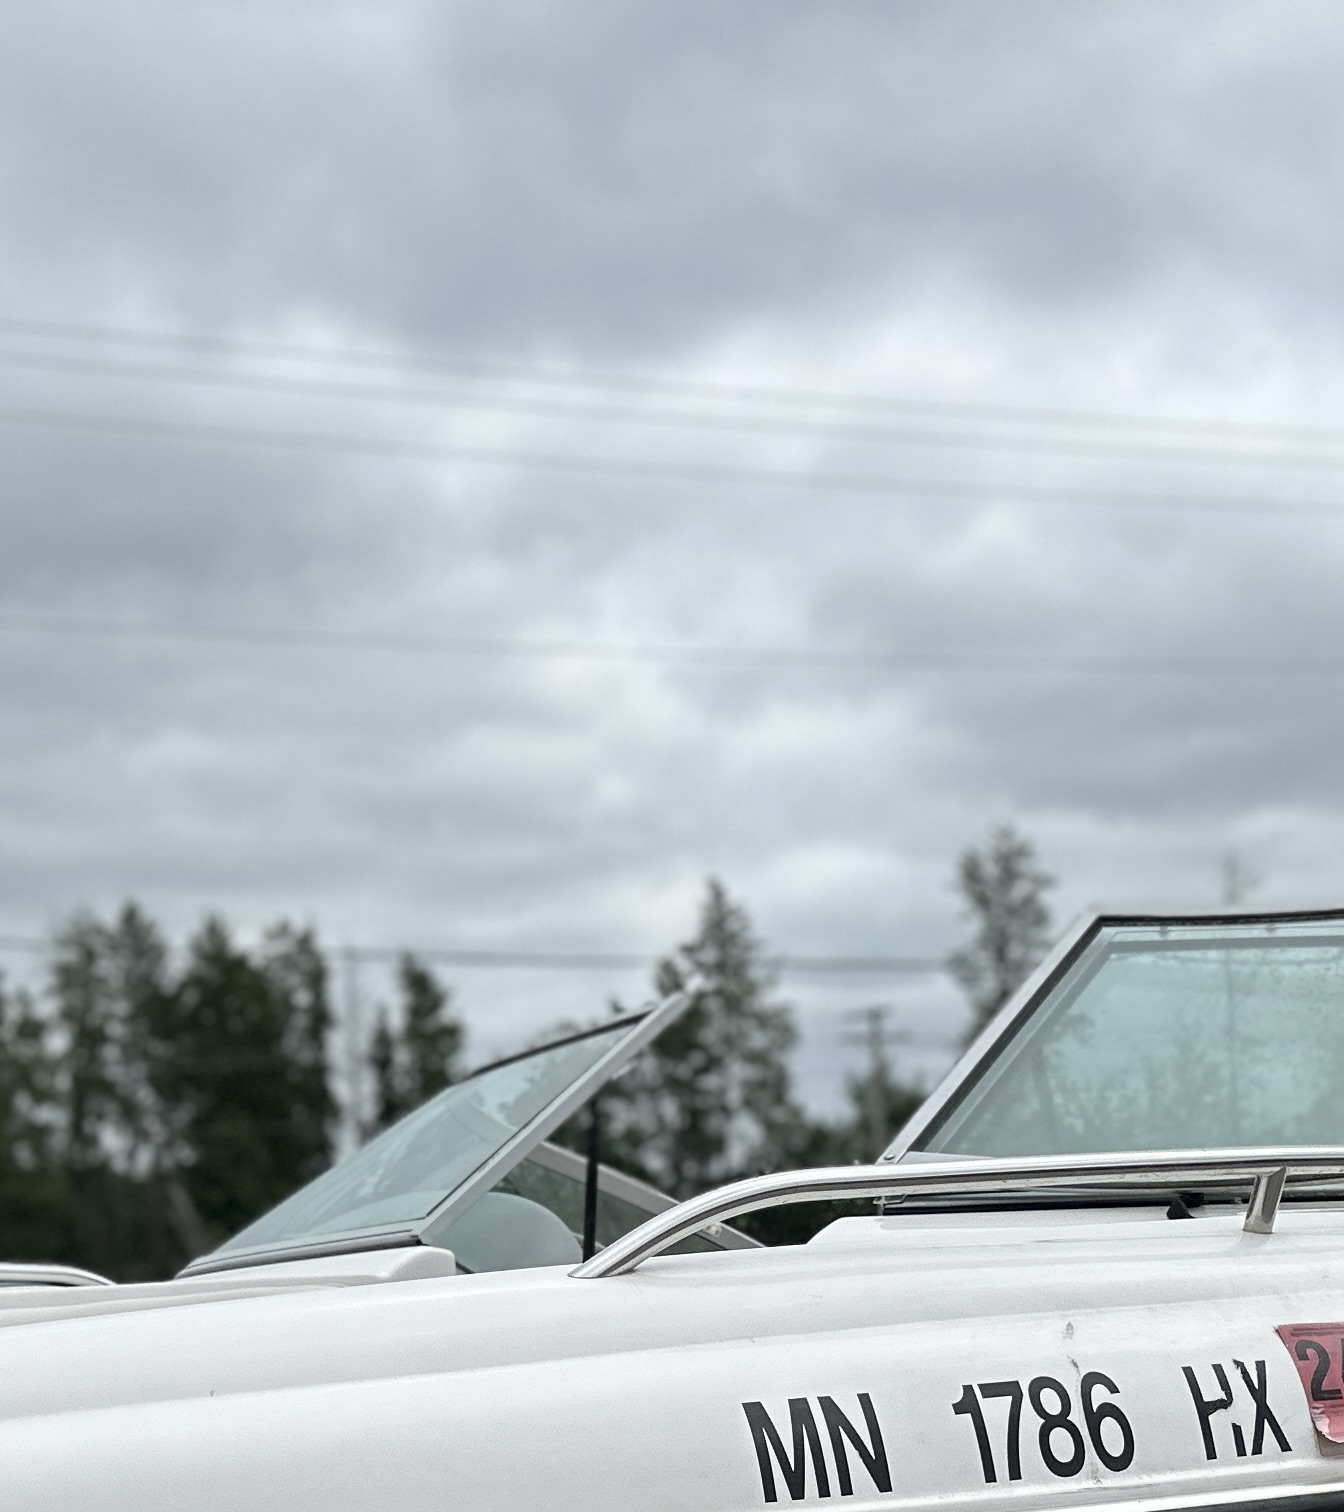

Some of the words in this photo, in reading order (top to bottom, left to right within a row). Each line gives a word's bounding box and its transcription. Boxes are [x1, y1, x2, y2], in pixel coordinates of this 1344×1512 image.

[742, 1392, 894, 1504] MN
[951, 1371, 1136, 1485] 1786
[1181, 1357, 1293, 1462] HX
